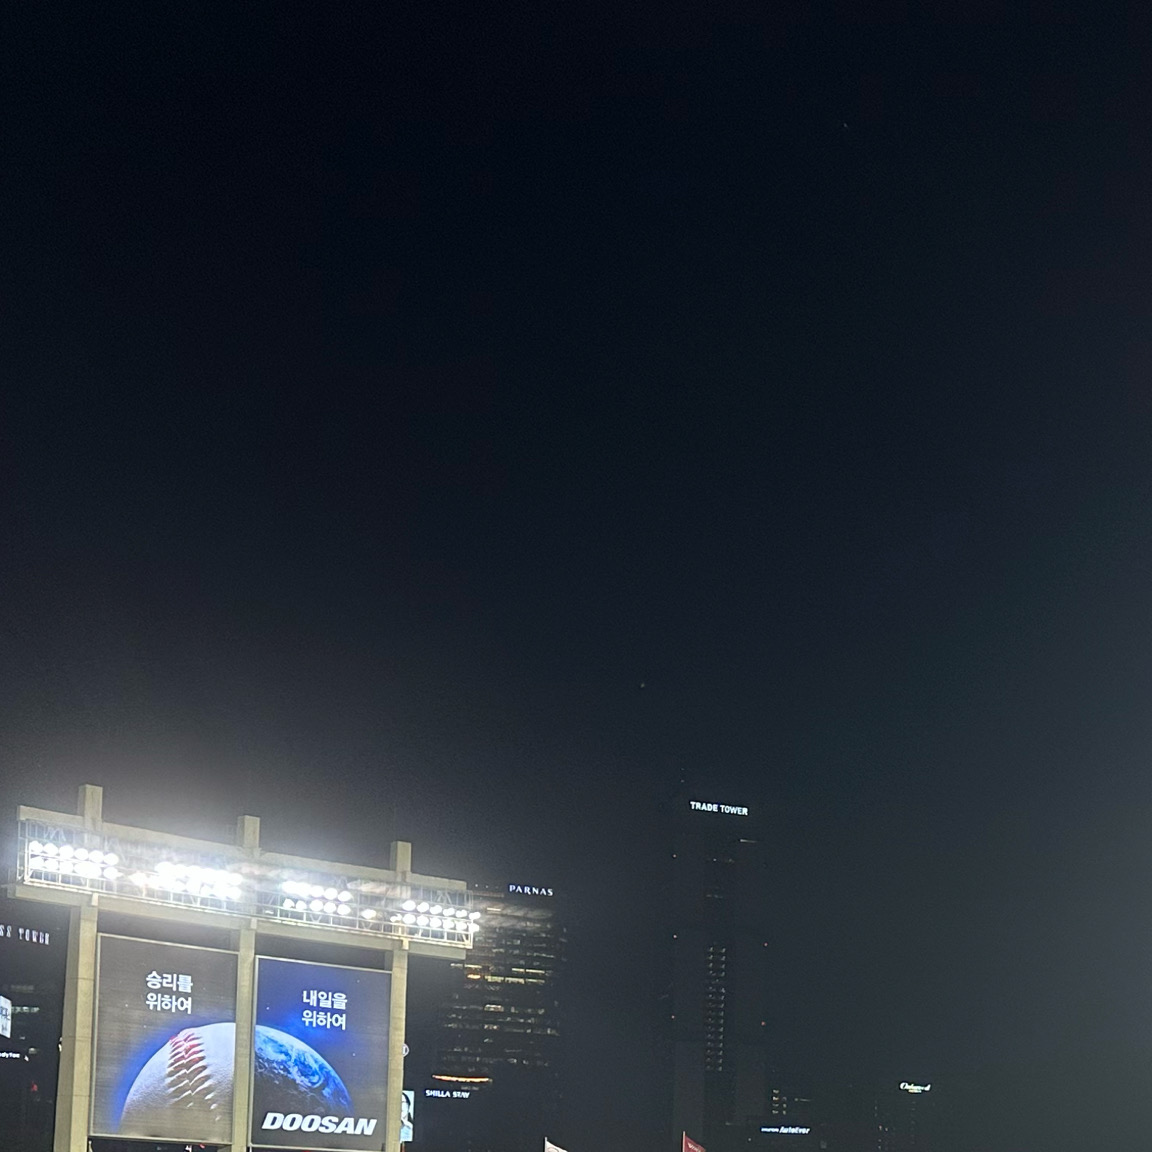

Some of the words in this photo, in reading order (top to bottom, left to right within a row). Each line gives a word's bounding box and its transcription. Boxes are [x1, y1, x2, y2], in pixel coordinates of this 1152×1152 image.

[690, 801, 718, 812] TRADE
[720, 804, 748, 816] TOWER
[509, 884, 554, 896] PARNAS
[146, 971, 193, 993] 승리를
[146, 993, 192, 1014] 위하여
[302, 990, 348, 1010] 내일을
[302, 1010, 346, 1030] 위하여
[425, 1089, 450, 1098] SHILLA
[262, 1112, 377, 1135] DOOSAN
